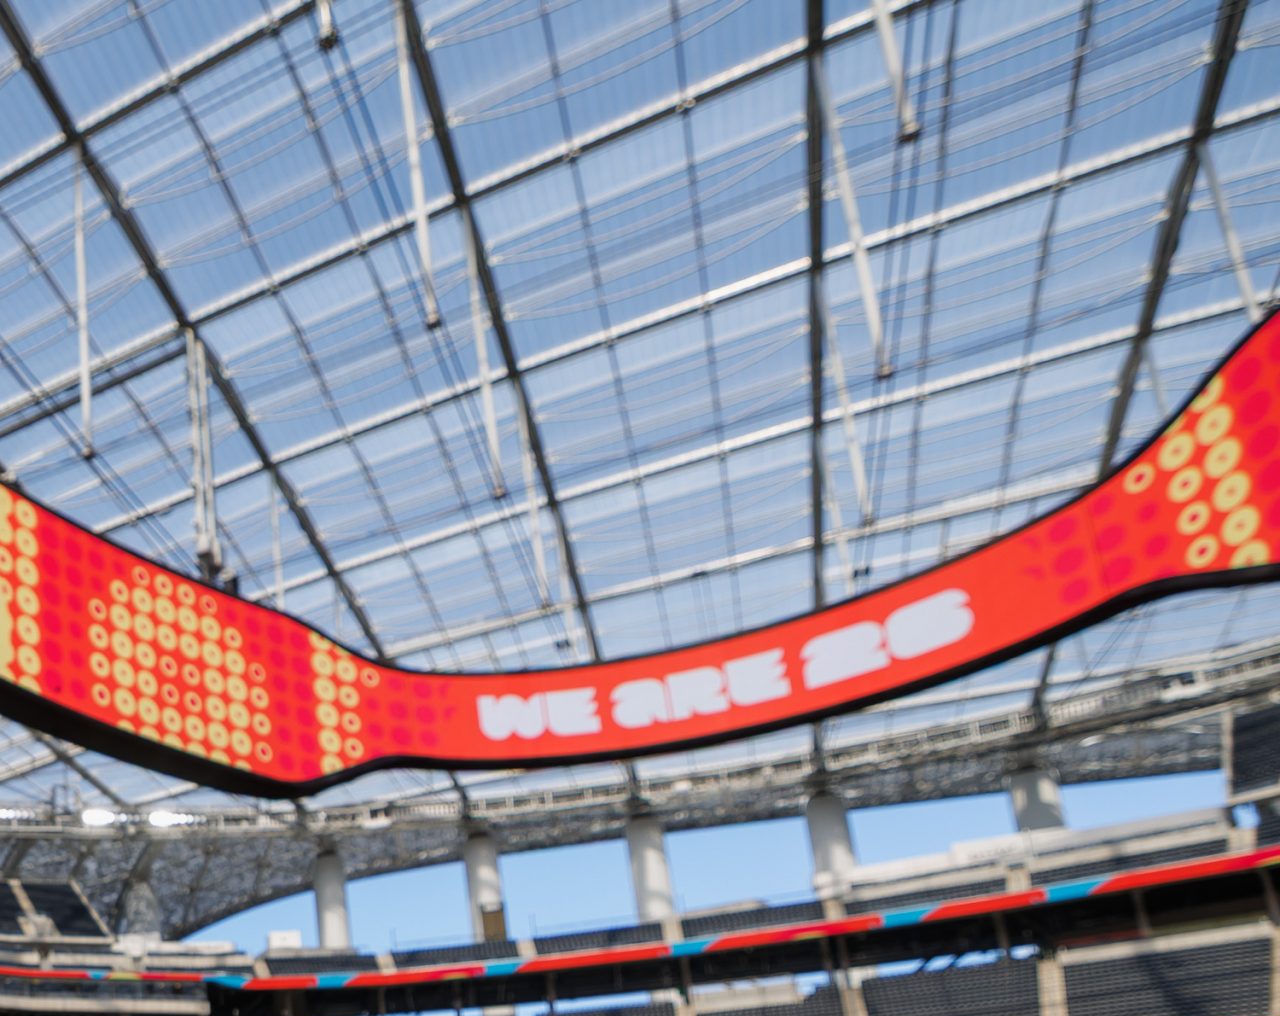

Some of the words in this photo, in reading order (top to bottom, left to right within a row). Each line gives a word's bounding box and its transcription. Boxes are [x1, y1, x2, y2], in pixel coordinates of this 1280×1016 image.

[476, 687, 602, 741] WE
[610, 648, 792, 729] ARE
[800, 588, 974, 690] 26
